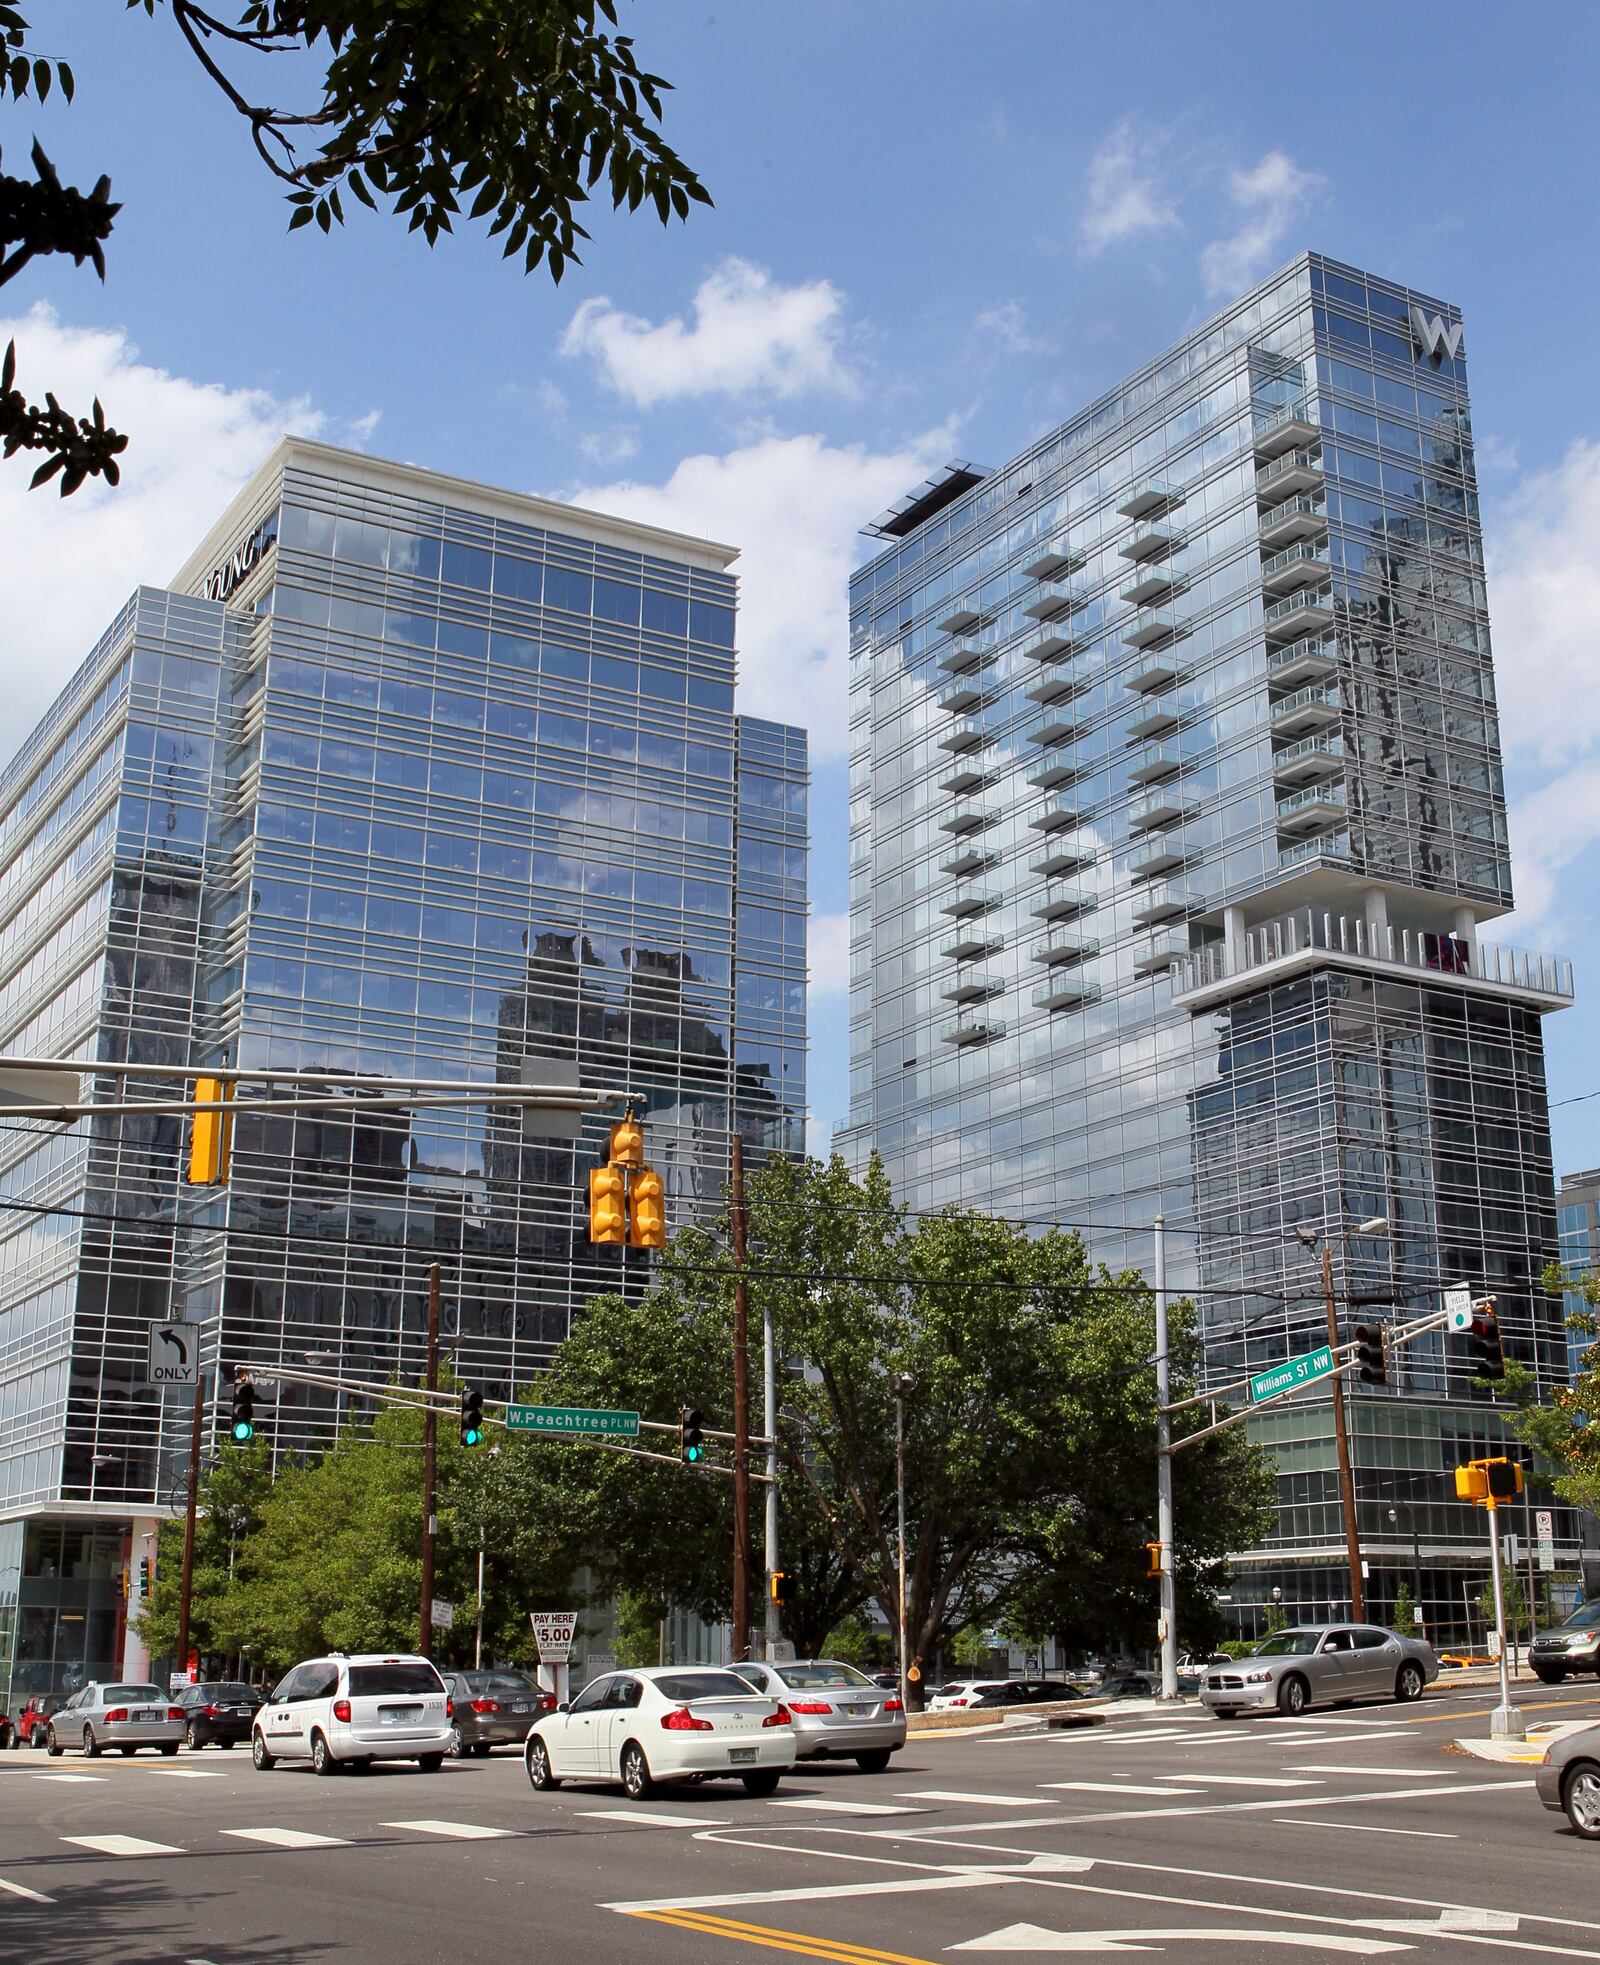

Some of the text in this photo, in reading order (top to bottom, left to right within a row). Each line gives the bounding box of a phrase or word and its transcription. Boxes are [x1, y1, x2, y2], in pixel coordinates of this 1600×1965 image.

[1410, 306, 1463, 361] W
[154, 1366, 192, 1380] ONLY
[1256, 1353, 1329, 1395] Williams ST NW
[610, 1417, 622, 1428] PL
[623, 1418, 637, 1429] NW
[534, 1614, 574, 1624] PAY HERE
[536, 1627, 571, 1642] $5.00
[428, 1701, 443, 1711] 1535
